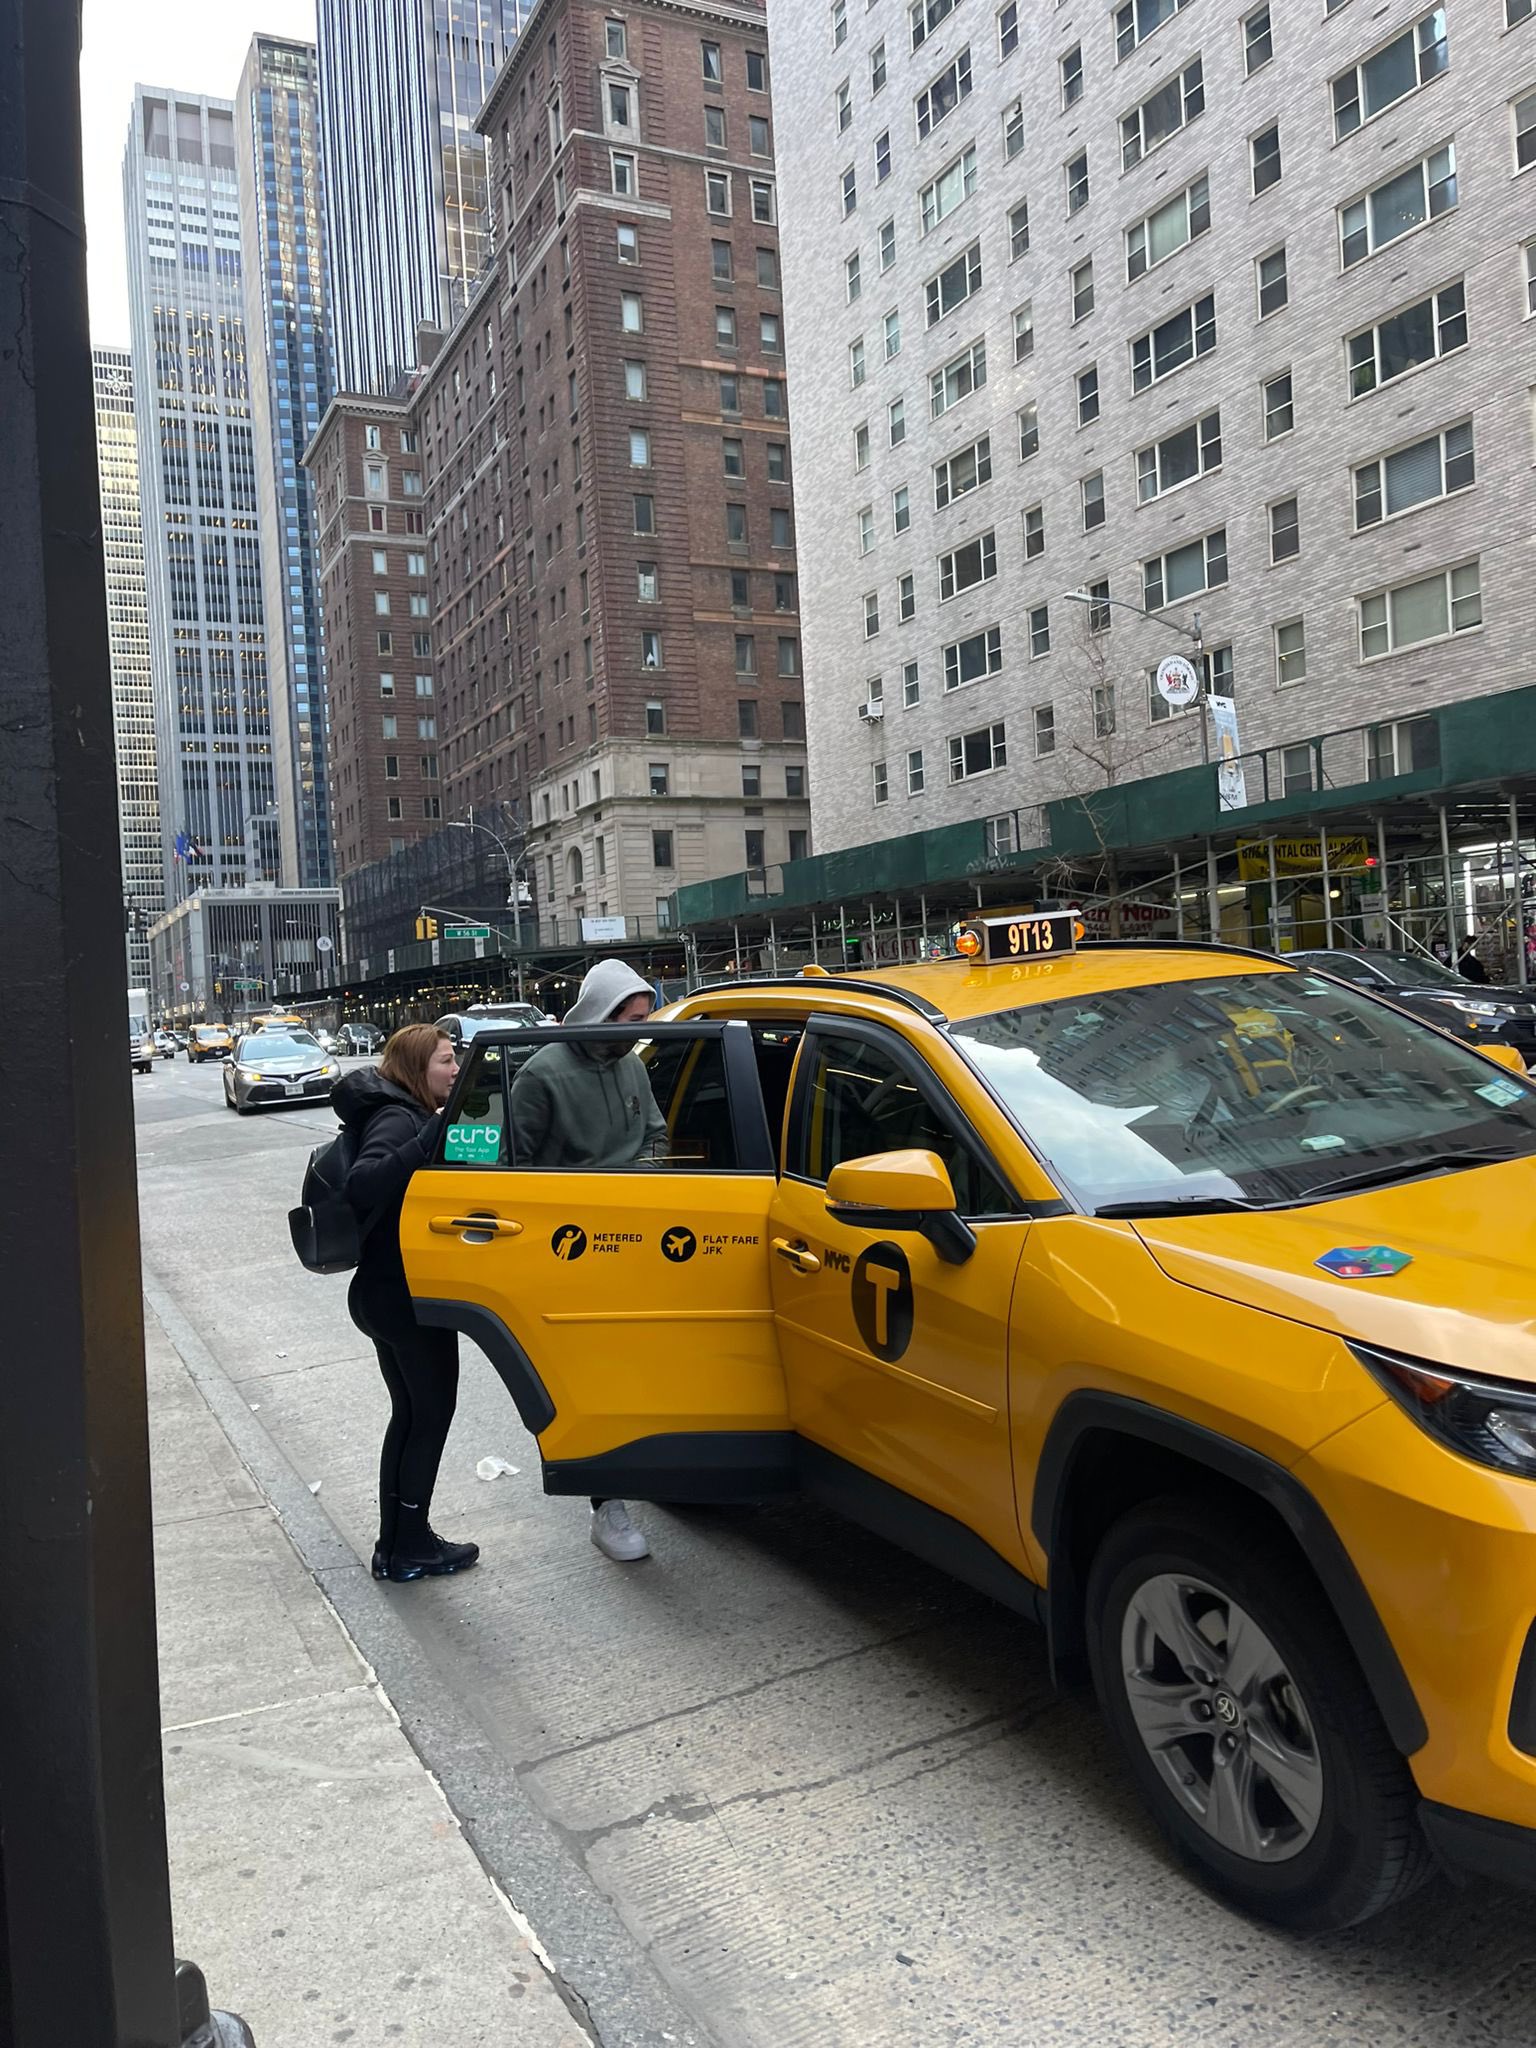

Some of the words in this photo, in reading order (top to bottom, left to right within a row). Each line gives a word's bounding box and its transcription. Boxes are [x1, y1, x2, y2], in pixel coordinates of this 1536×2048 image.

[1264, 844, 1298, 858] RNTAL
[1300, 842, 1337, 857] CENTAL
[1008, 920, 1053, 954] 9T13
[447, 1126, 499, 1144] curb
[593, 1233, 642, 1243] METERED
[702, 1235, 728, 1244] FLAT
[732, 1236, 759, 1245] FARE
[593, 1244, 619, 1253] FARE
[702, 1246, 723, 1255] JFK
[824, 1249, 850, 1273] NYC
[866, 1262, 900, 1346] T
